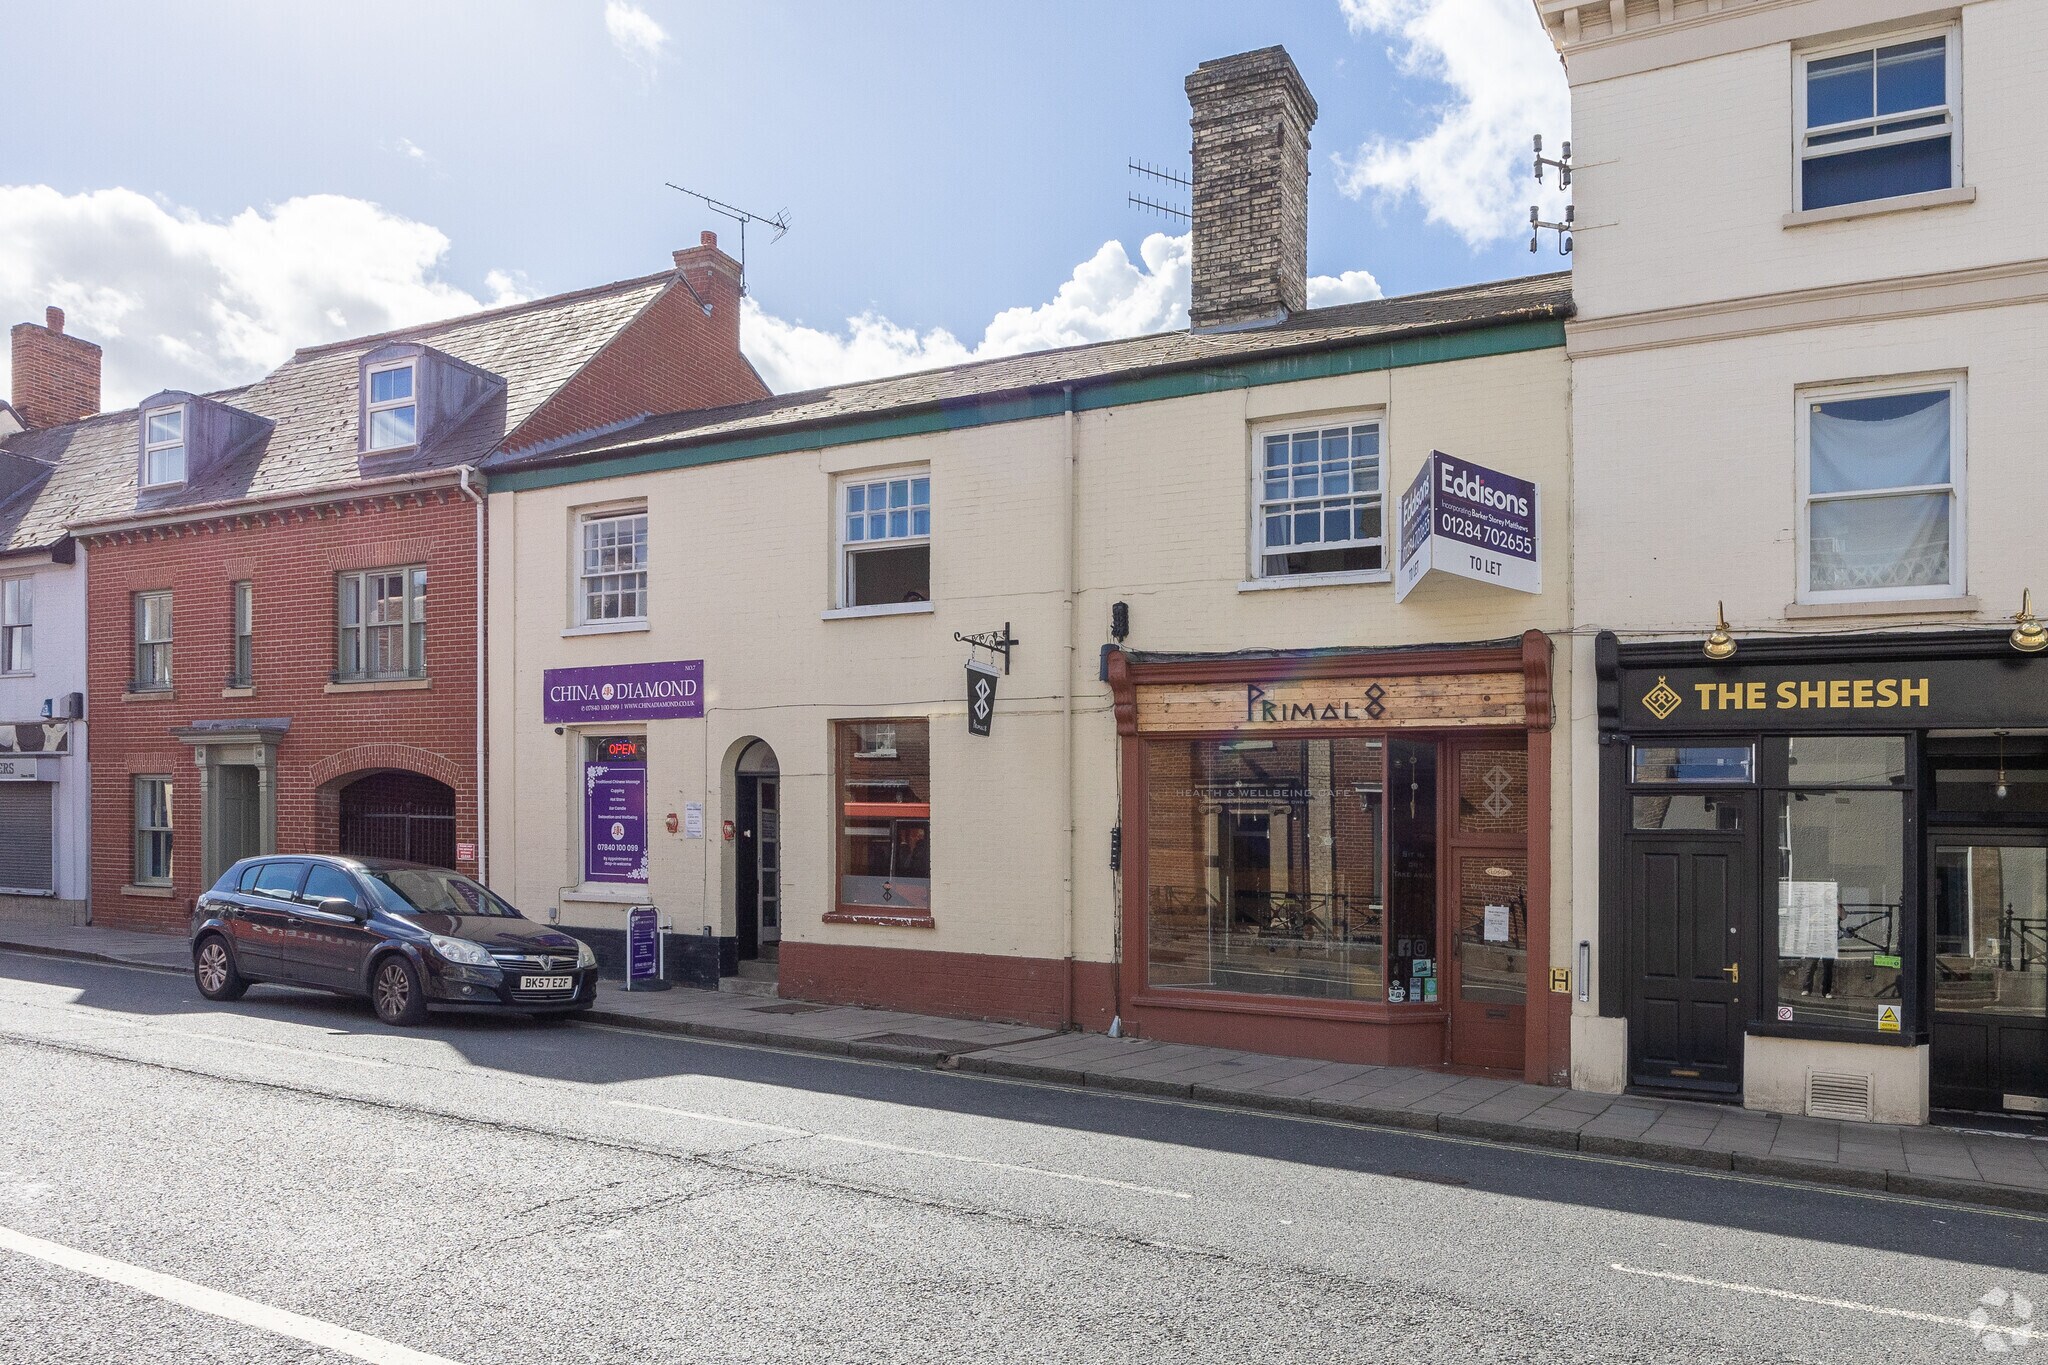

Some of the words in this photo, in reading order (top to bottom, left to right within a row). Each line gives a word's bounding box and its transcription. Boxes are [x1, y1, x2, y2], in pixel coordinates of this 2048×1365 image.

[1441, 462, 1529, 517] Eddisons
[1441, 499, 1471, 517] Incorporating
[1472, 509, 1488, 521] Barker
[1488, 514, 1505, 527] Storey
[1505, 519, 1528, 533] Matthews
[1442, 513, 1481, 540] 01284
[1484, 526, 1532, 554] 702655
[1470, 555, 1482, 571] TO
[1485, 560, 1502, 576] LET
[551, 685, 600, 702] CHINA
[617, 679, 697, 700] DIAMOND
[1694, 682, 1767, 711] THE
[1776, 678, 1929, 710] SHEESH
[624, 700, 695, 709] WWW.CHINADIAMOND.CO.UK
[609, 743, 636, 754] OPEN
[1176, 789, 1222, 797] HEALTH
[1226, 789, 1235, 797] &
[1239, 789, 1312, 797] WELLBEING
[1318, 789, 1351, 797] CAFE
[627, 844, 639, 852] 099
[525, 978, 551, 988] BK57
[553, 978, 569, 988] EZF
[1552, 969, 1568, 991] H
